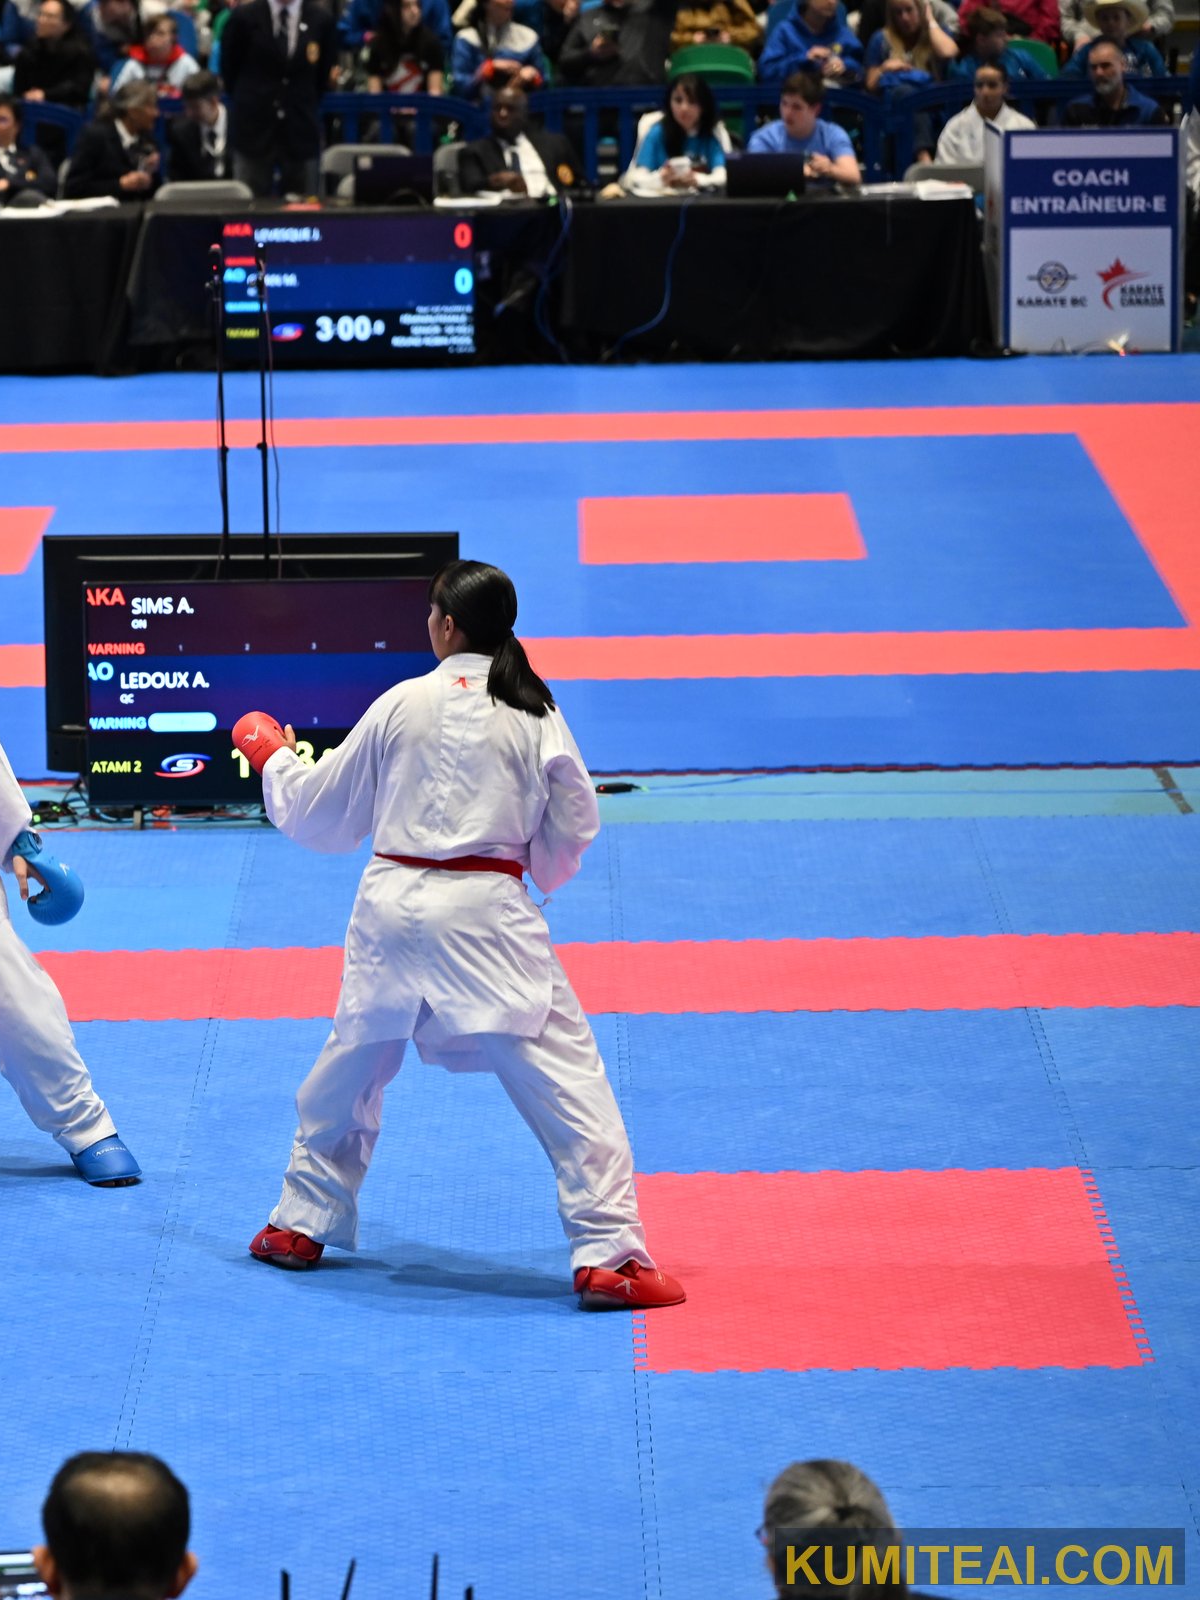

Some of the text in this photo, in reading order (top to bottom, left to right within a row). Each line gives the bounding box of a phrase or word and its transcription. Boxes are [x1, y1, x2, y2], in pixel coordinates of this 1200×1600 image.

[1052, 169, 1130, 187] COACH
[454, 222, 473, 248] 0
[454, 268, 473, 294] 0
[1121, 284, 1165, 294] KARATE
[1017, 296, 1088, 307] KARATE BC
[1121, 296, 1165, 307] CANADA
[131, 597, 195, 615] SIMS A.
[131, 618, 148, 629] ON
[120, 671, 210, 689] LEDOUX A.
[119, 693, 135, 704] QC
[90, 759, 142, 773] ATAMI 2
